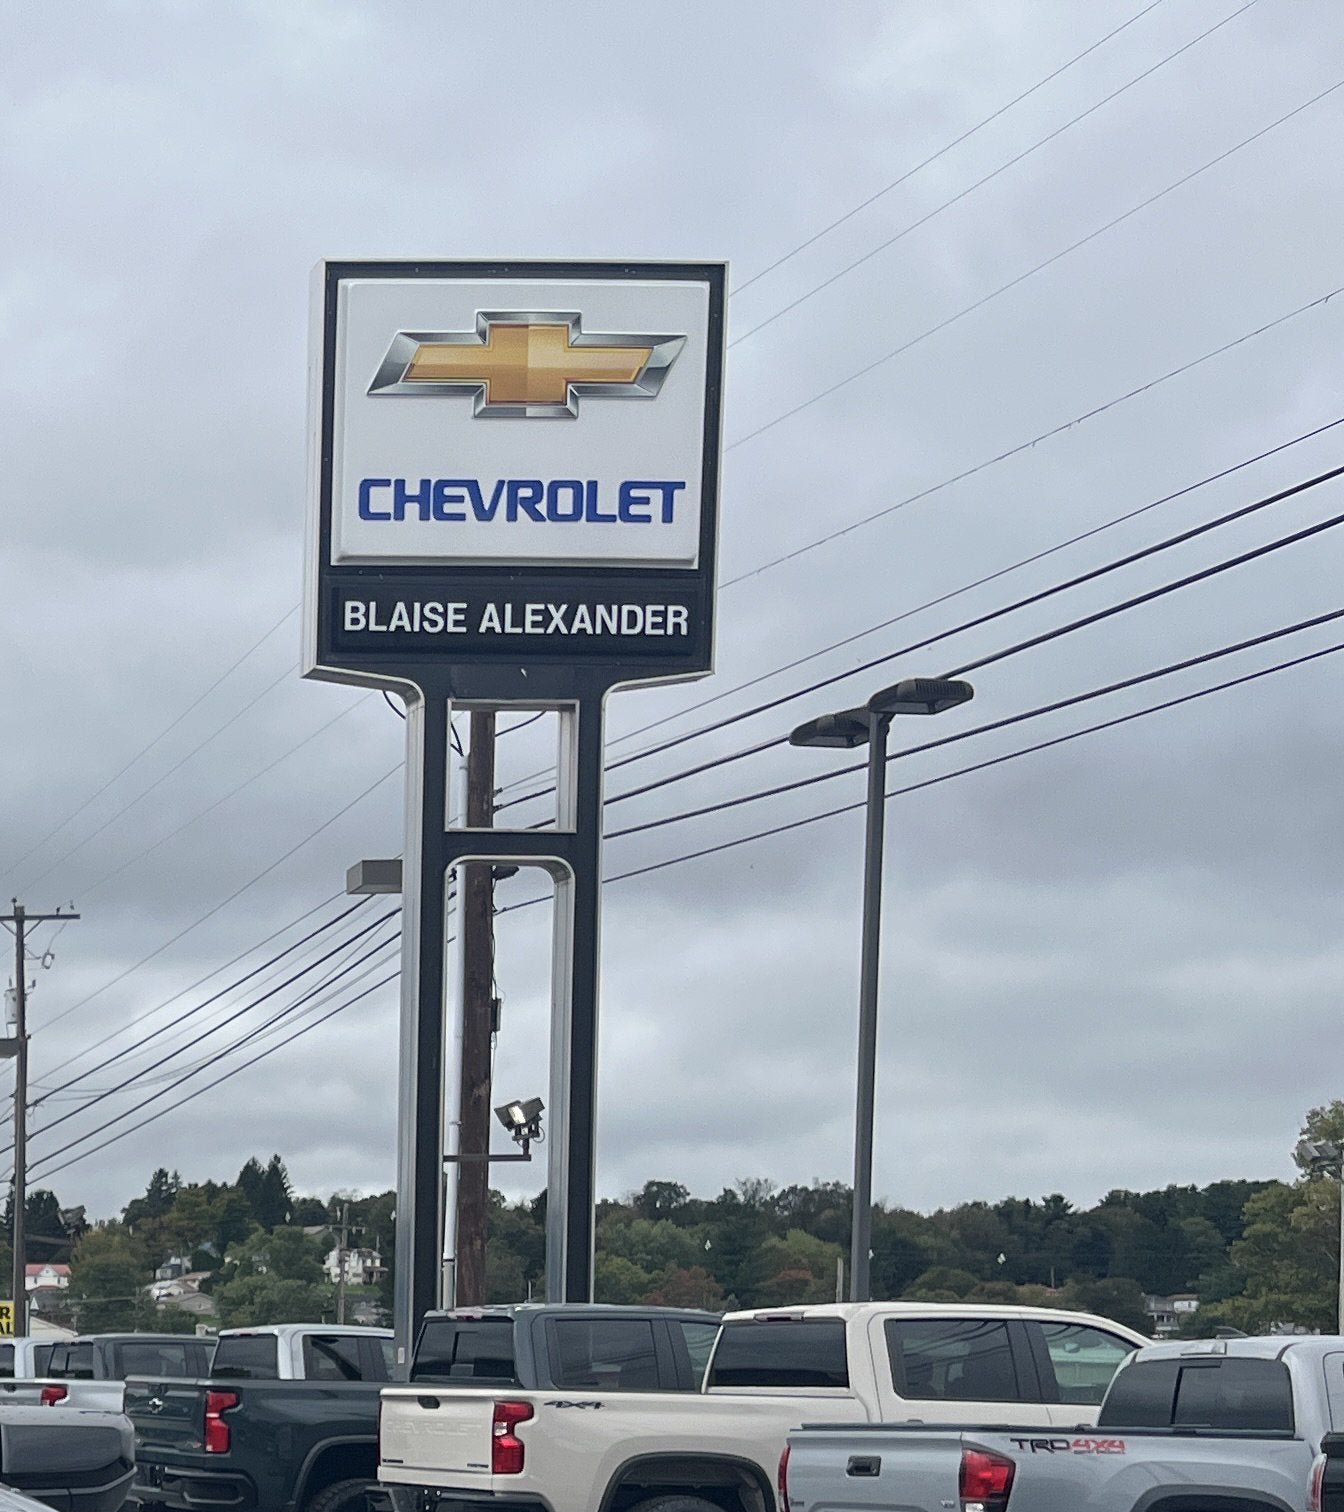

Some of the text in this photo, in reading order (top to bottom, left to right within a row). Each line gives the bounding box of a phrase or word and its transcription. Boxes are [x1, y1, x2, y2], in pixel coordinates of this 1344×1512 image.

[358, 478, 686, 524] CHEVROLET
[343, 600, 689, 636] BLAISE ALEXANDER
[1010, 1438, 1071, 1453] TRD
